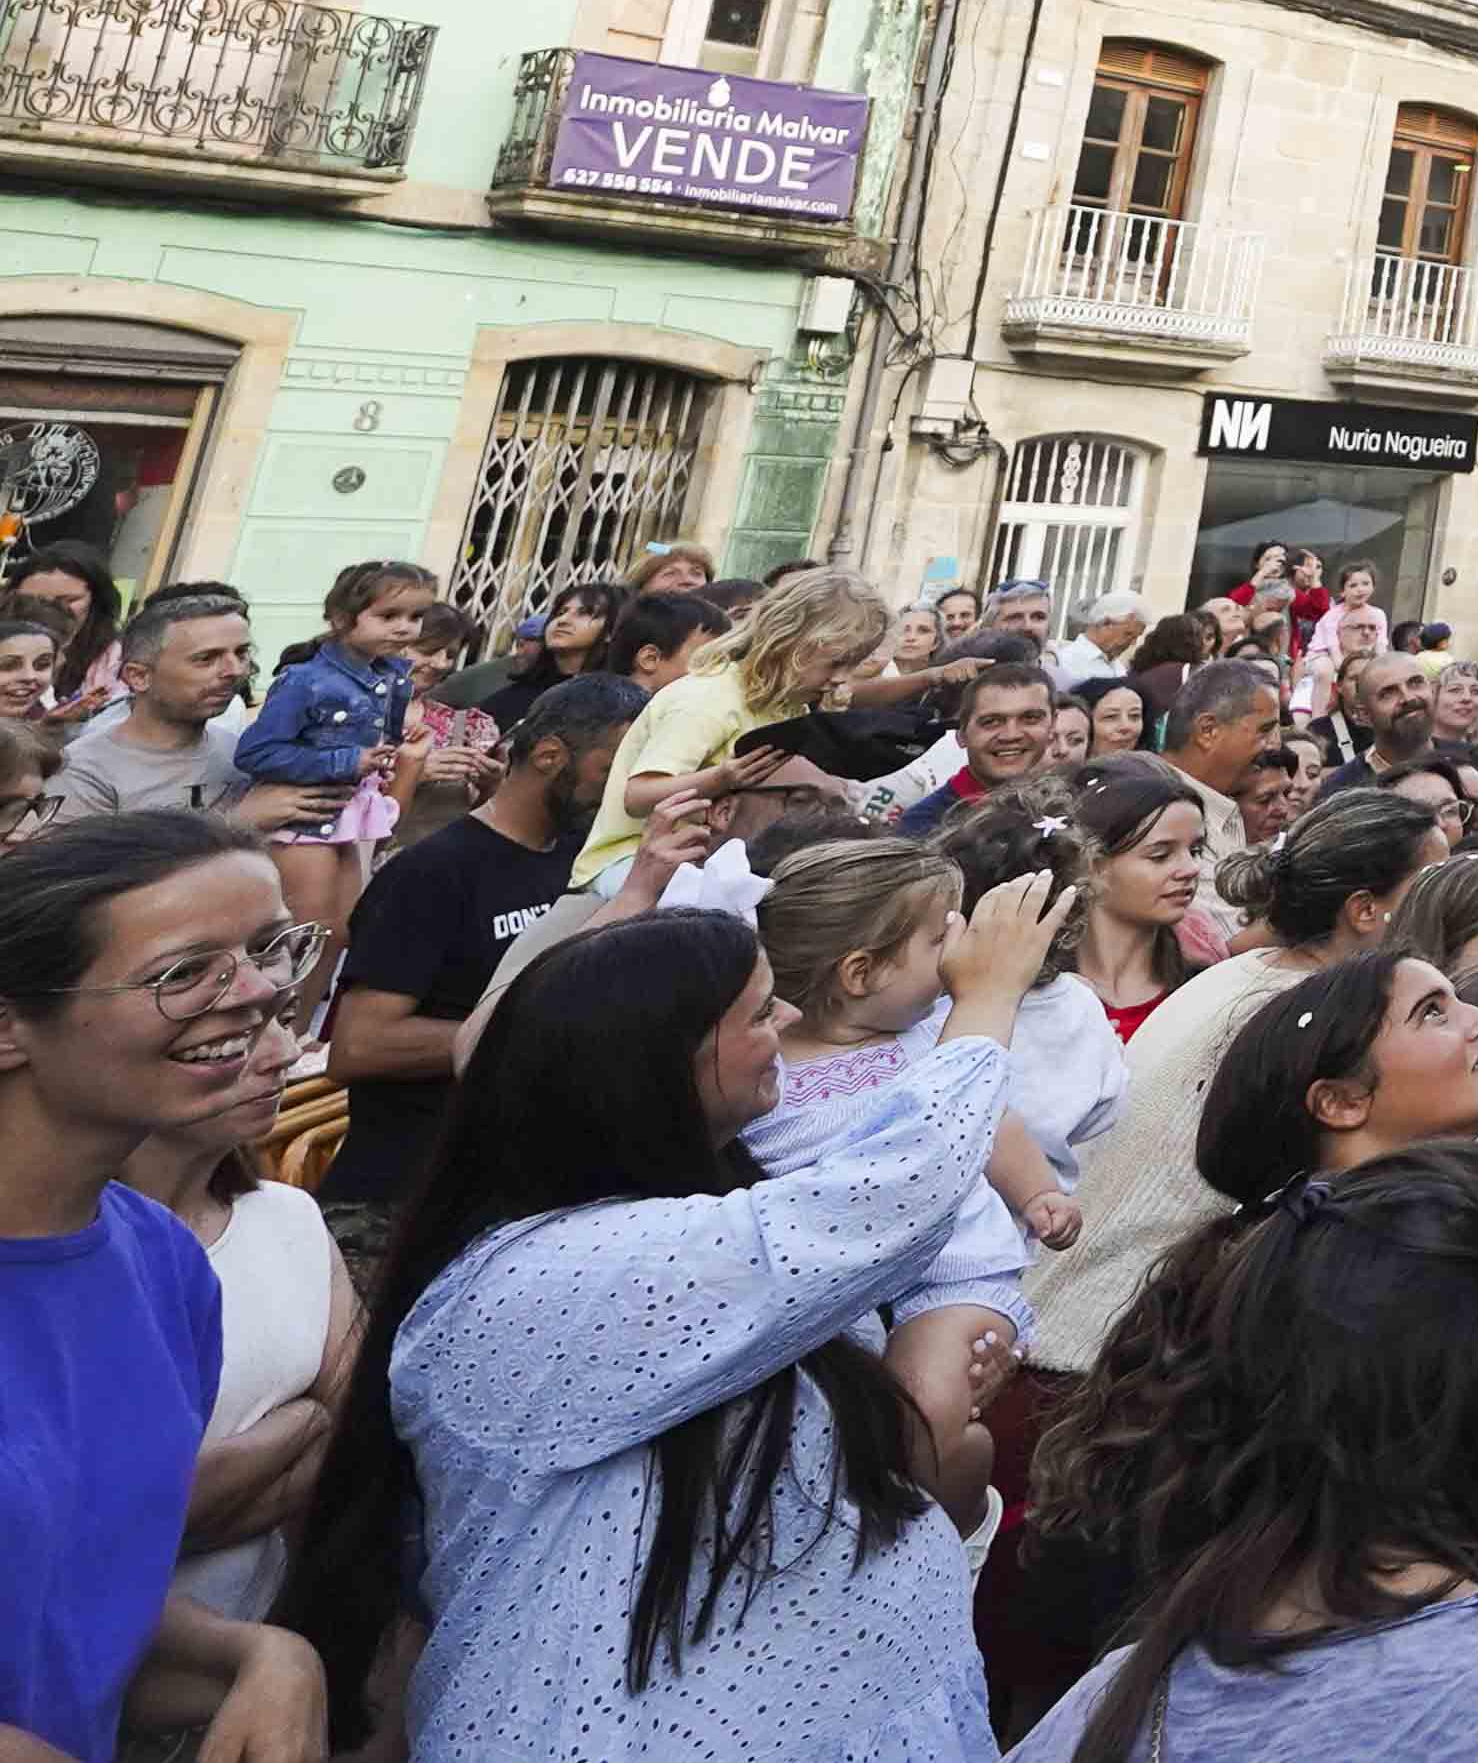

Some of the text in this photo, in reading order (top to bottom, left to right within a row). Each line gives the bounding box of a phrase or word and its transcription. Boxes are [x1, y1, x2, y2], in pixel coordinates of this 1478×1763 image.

[580, 84, 850, 146] Inmobiliaria Malvar
[611, 121, 816, 190] VENDE
[563, 168, 600, 187] 627
[354, 400, 383, 432] 8
[1328, 425, 1381, 452] Nuria
[1384, 429, 1468, 462] Nogueira
